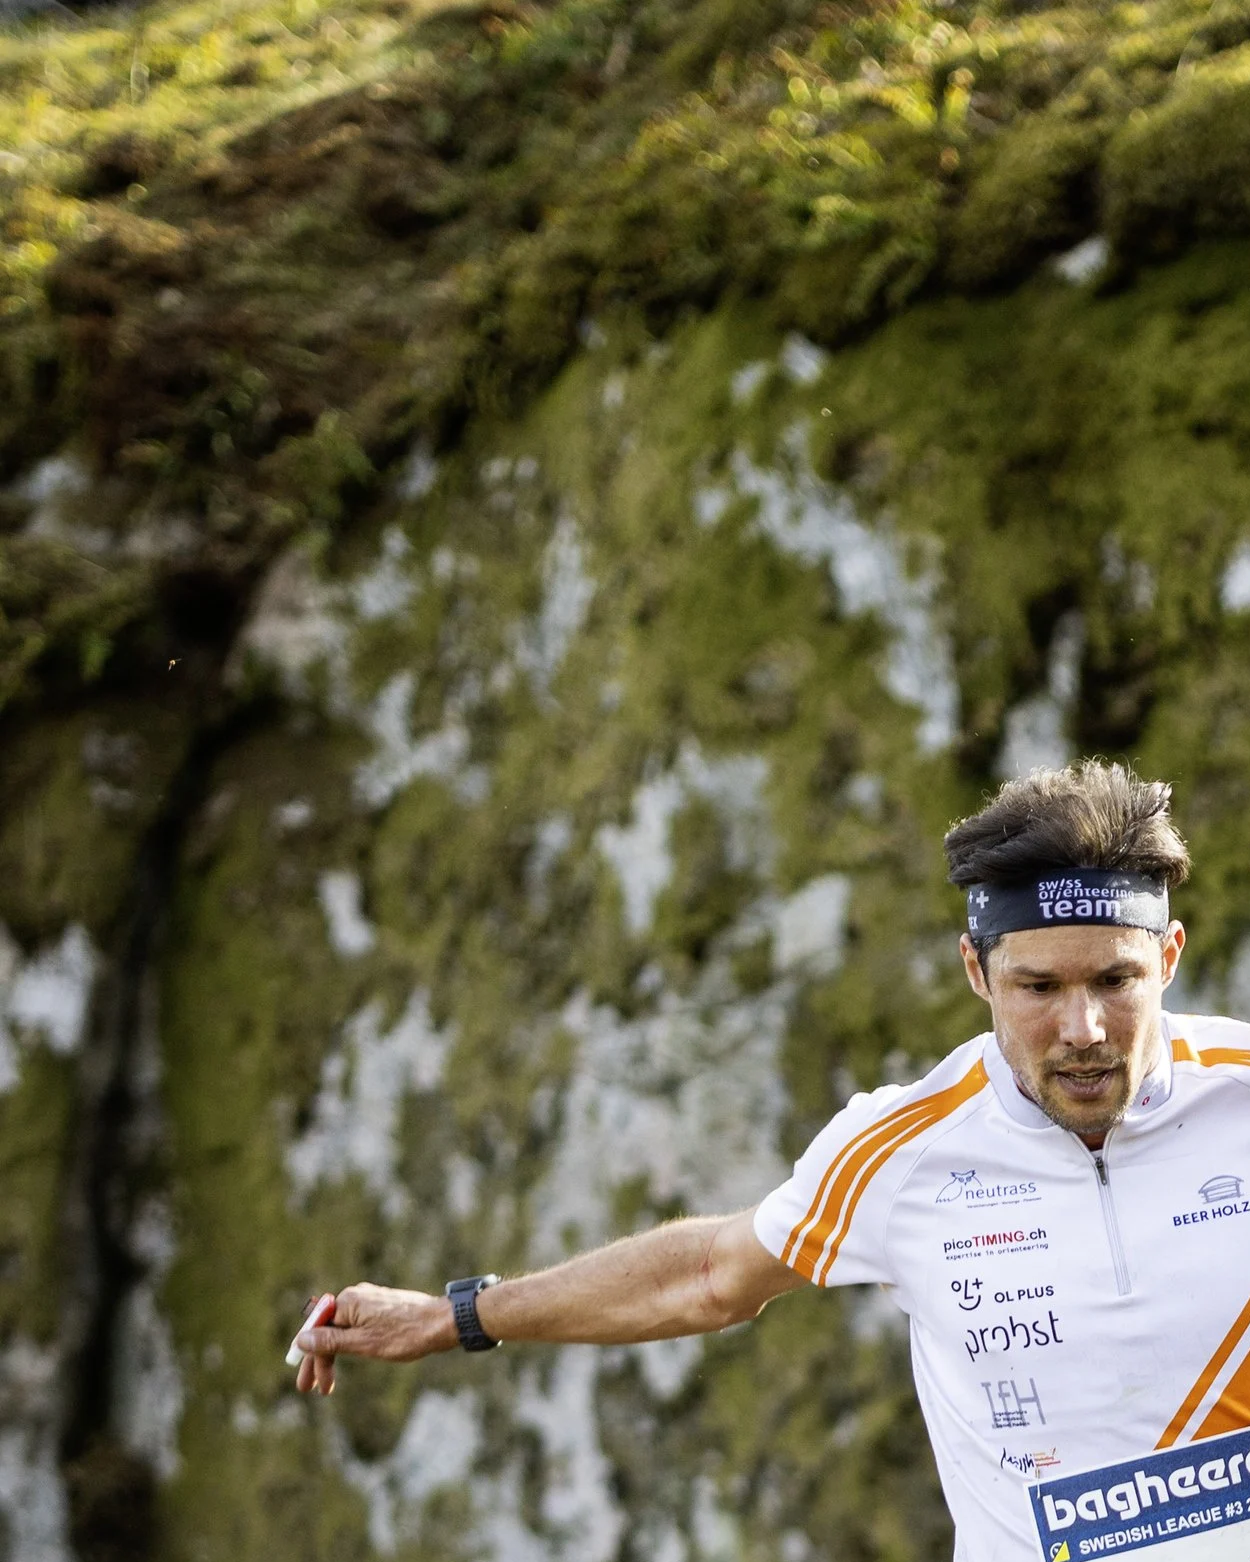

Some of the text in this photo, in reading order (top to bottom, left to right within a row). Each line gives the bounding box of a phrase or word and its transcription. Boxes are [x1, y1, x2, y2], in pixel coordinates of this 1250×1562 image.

[1039, 879, 1082, 891] swiss
[1039, 899, 1121, 919] team
[965, 1182, 1037, 1200] neutrass
[1173, 1210, 1209, 1226] BEER
[943, 1228, 1047, 1253] picoTIMING.ch
[946, 1251, 981, 1261] expertise
[998, 1243, 1049, 1255] orienteering
[994, 1285, 1054, 1303] OL PLUS
[1079, 1524, 1153, 1555] SWEDISH
[1156, 1507, 1223, 1536] LEAGUE
[1225, 1502, 1243, 1518] #3
